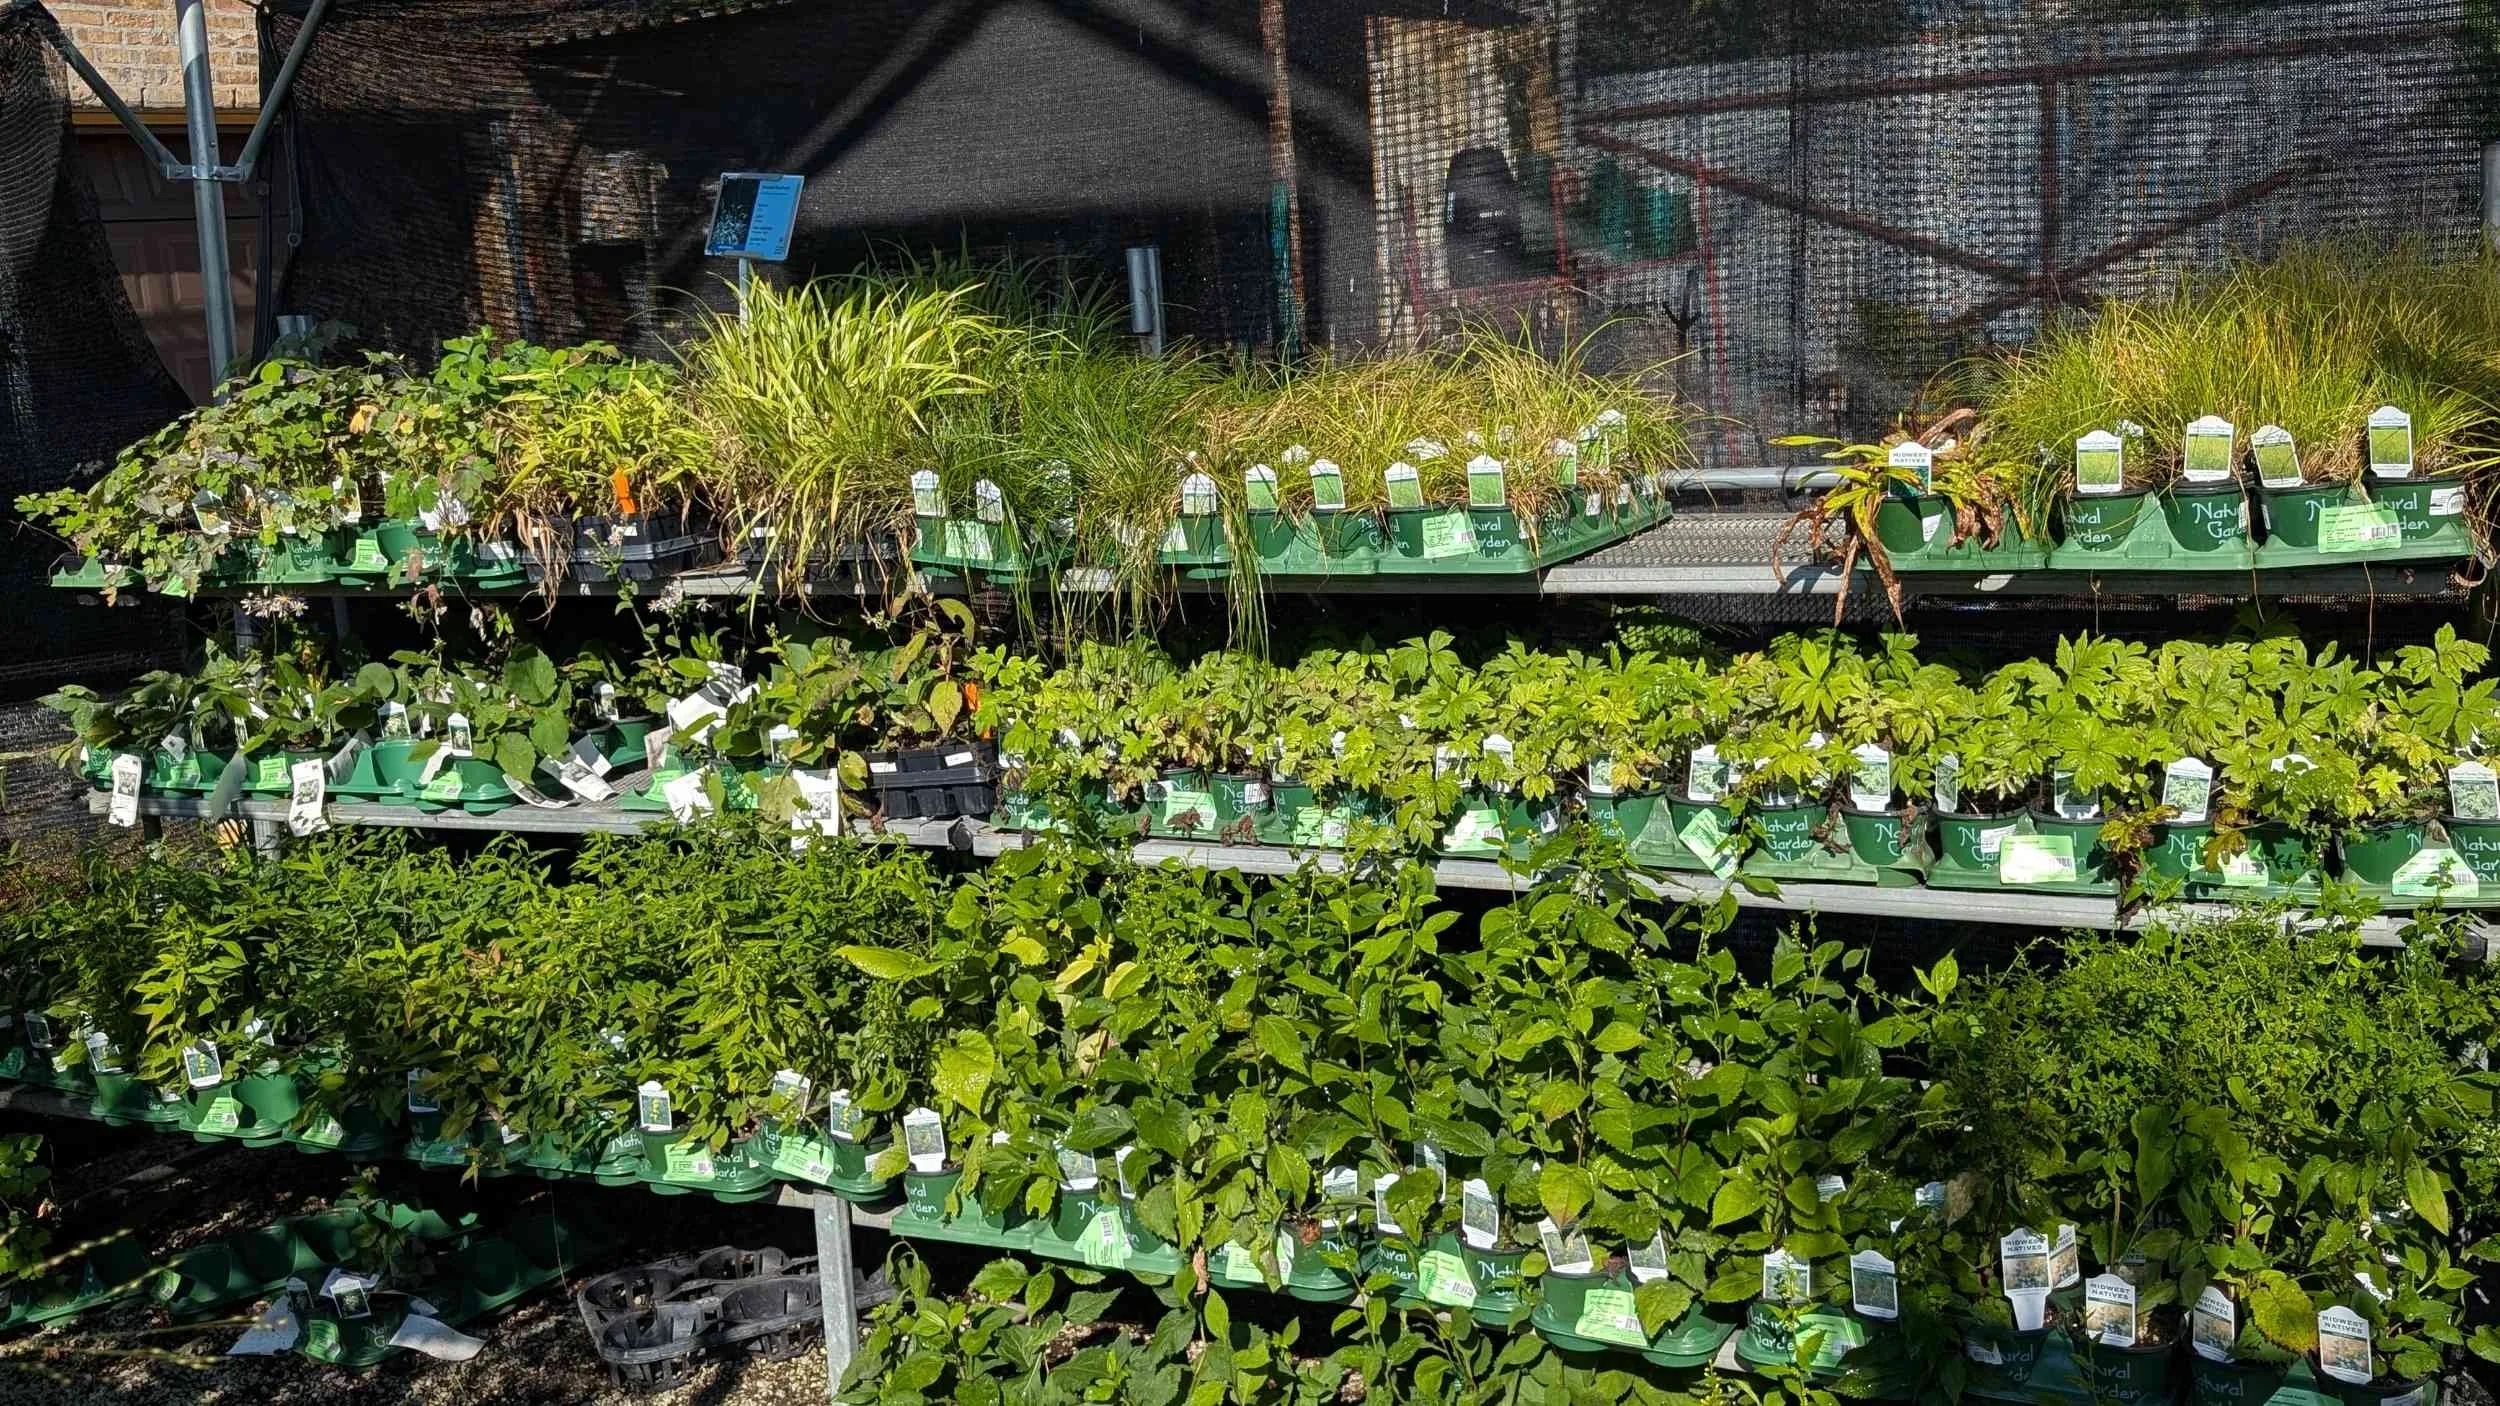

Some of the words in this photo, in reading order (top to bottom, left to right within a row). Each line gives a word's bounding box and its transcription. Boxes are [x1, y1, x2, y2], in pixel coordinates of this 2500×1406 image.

[2191, 501, 2237, 524] Natu
[2400, 515, 2430, 530] den
[1755, 815, 1808, 832] Natural
[2451, 831, 2500, 852] Natu
[2008, 1244, 2042, 1252] NATIVES
[2090, 1283, 2130, 1294] MIDWEST
[2091, 1289, 2129, 1300] NATIVES
[2322, 1315, 2364, 1328] MIDWEST
[2324, 1322, 2363, 1334] NATIVES
